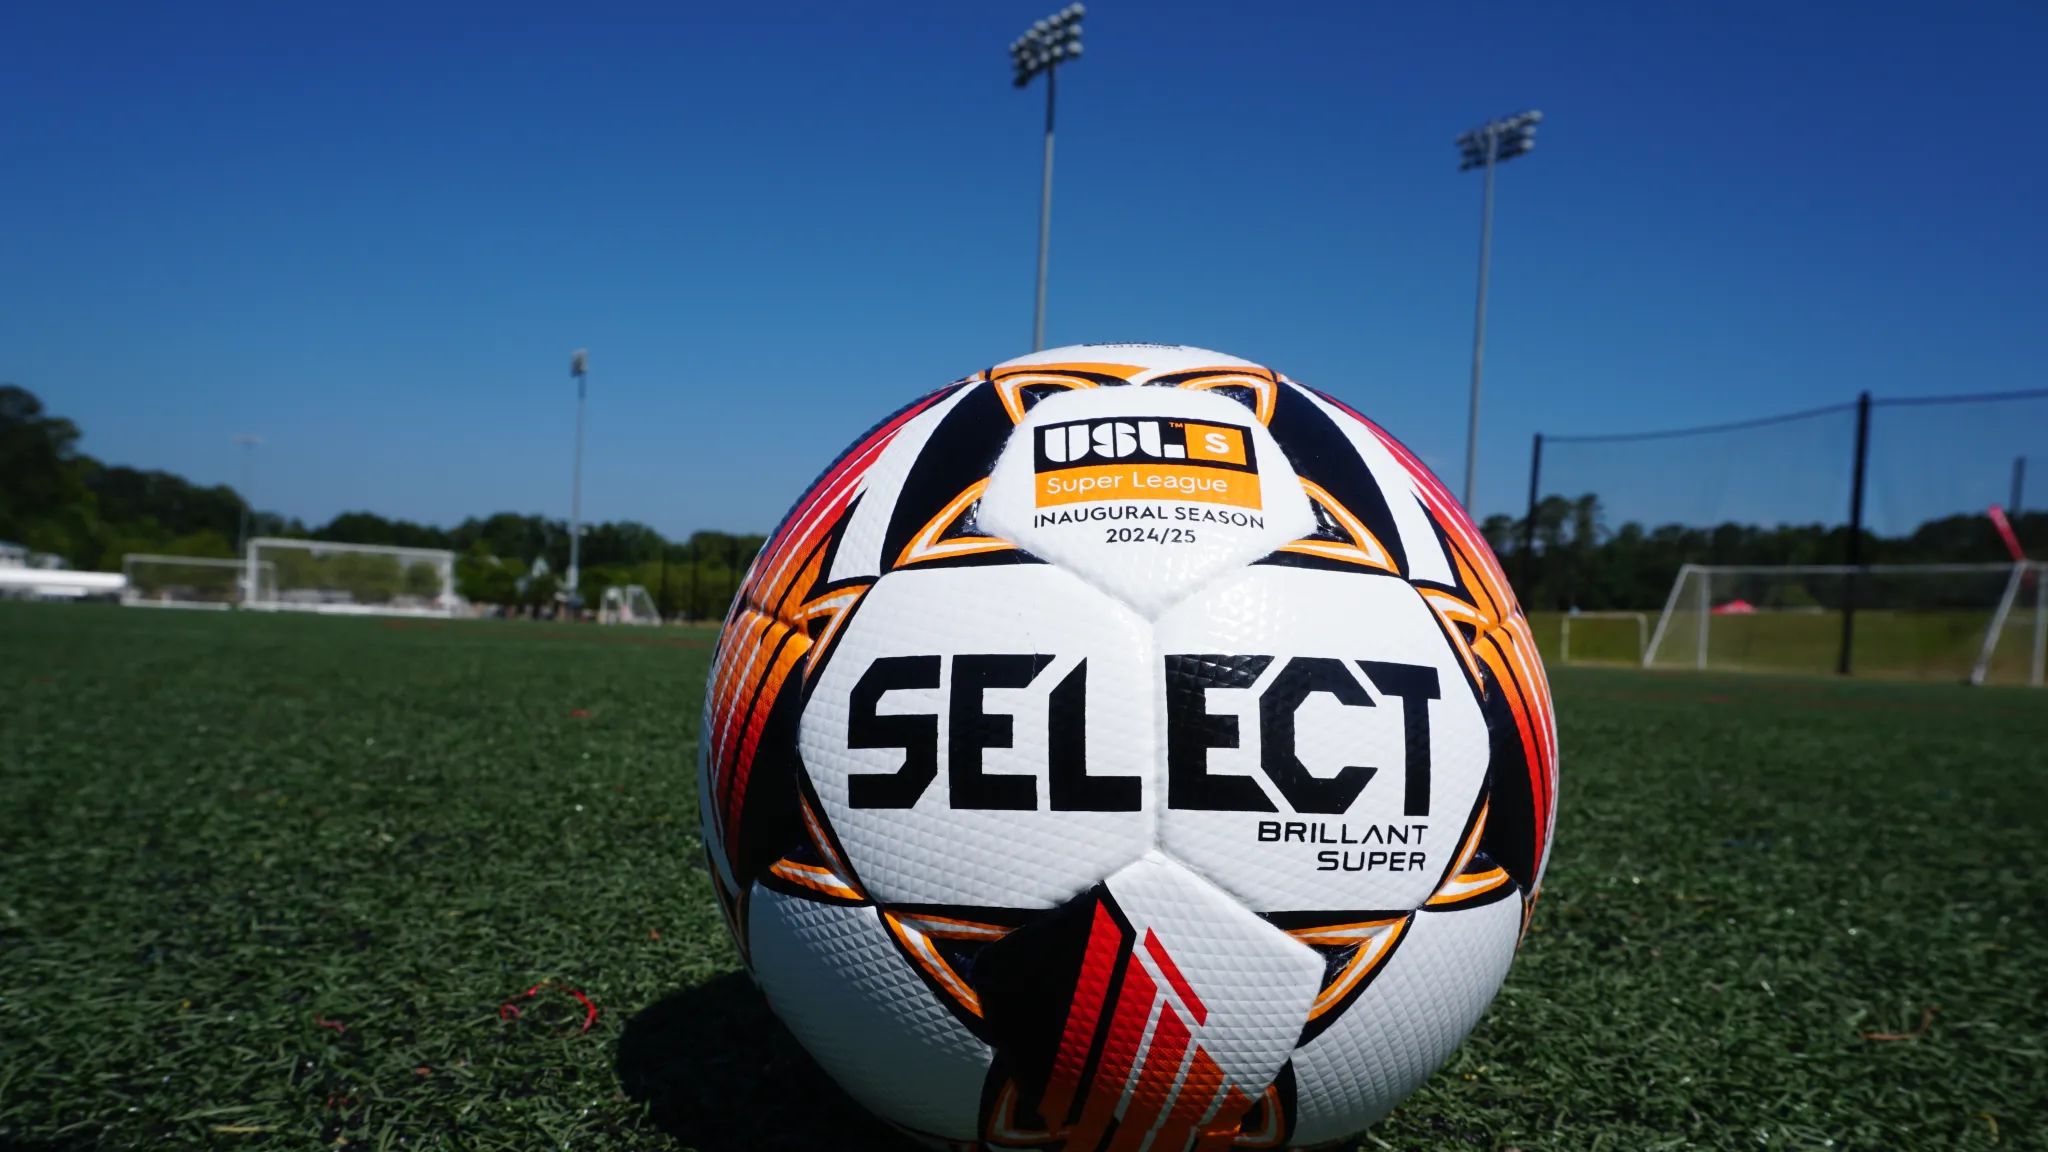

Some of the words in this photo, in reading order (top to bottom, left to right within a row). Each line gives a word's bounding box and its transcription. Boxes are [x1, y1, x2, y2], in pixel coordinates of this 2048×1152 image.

[1044, 421, 1186, 463] USL
[1047, 474, 1124, 495] Super
[1132, 471, 1229, 494] League
[1034, 505, 1168, 529] INAUGURAL
[1174, 506, 1265, 530] SEASON
[1105, 527, 1196, 545] 2024/25
[848, 654, 1441, 817] SELECT
[1257, 821, 1429, 846] BRILLANT
[1316, 850, 1426, 872] SUPER
